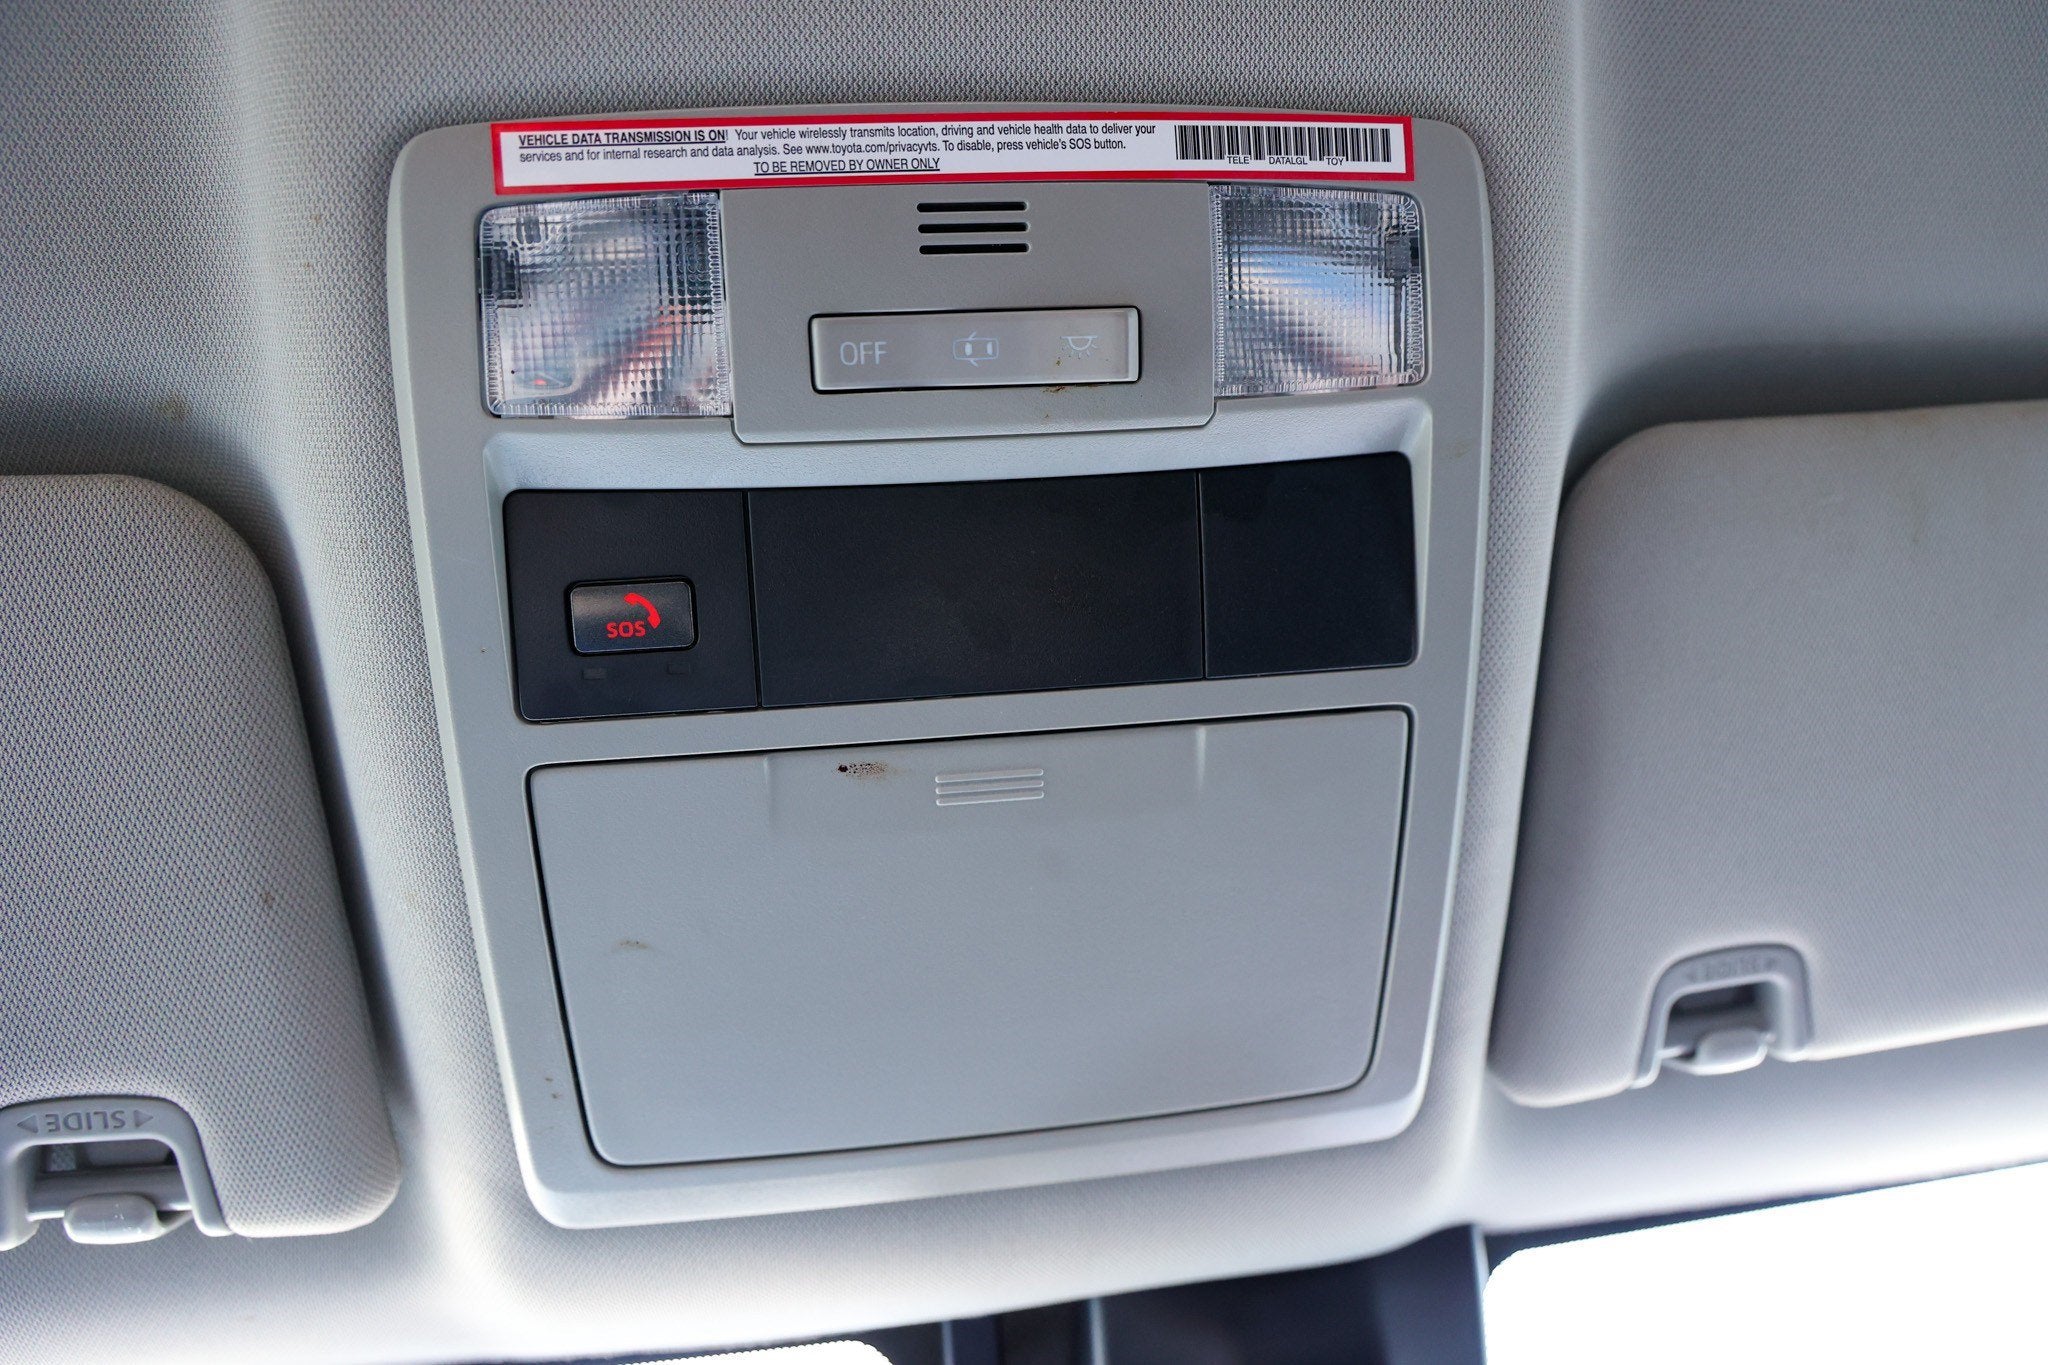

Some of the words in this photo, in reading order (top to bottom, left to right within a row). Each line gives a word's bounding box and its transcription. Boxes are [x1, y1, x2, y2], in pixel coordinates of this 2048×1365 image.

[519, 134, 568, 147] VEHICLE
[572, 133, 601, 145] DATA
[605, 131, 693, 144] TRANSMISSION
[694, 130, 705, 142] IS
[708, 129, 729, 142] ON!
[735, 129, 758, 141] Your
[760, 128, 796, 140] vehicle
[799, 126, 847, 141] wirelessly
[849, 126, 895, 138] transmits
[897, 125, 939, 138] location,
[941, 125, 974, 138] driving
[976, 124, 995, 135] and
[997, 124, 1031, 135] vehicle
[1034, 123, 1063, 134] health
[1065, 123, 1087, 134] data
[1089, 123, 1099, 134] to
[1101, 122, 1133, 134] deliver
[1134, 125, 1156, 136] your
[520, 150, 562, 163] services
[565, 150, 584, 161] and
[586, 149, 600, 161] for
[602, 148, 641, 160] internal
[643, 146, 688, 159] research
[690, 146, 709, 157] and
[711, 145, 734, 157] data
[736, 143, 780, 158] analysis.
[782, 143, 803, 155] See
[805, 140, 940, 155] www.toyota.com/privacyvts.
[942, 139, 955, 151] To
[956, 139, 995, 152] disable,
[997, 141, 1024, 153] press
[1025, 138, 1067, 150] vehicle's
[1069, 138, 1092, 149] SOS
[1094, 138, 1126, 149] button.
[1227, 155, 1250, 165] TELE
[1268, 156, 1308, 166] DATALGL
[1326, 157, 1345, 166] TOY
[753, 161, 769, 174] TO
[772, 161, 787, 173] BE
[790, 159, 846, 172] REMOVED
[849, 159, 864, 171] BY
[866, 158, 909, 171] OWNER
[910, 157, 940, 170] ONLY
[839, 341, 888, 366] OFF
[605, 620, 646, 639] SOS
[45, 1110, 126, 1132] SLIDE
